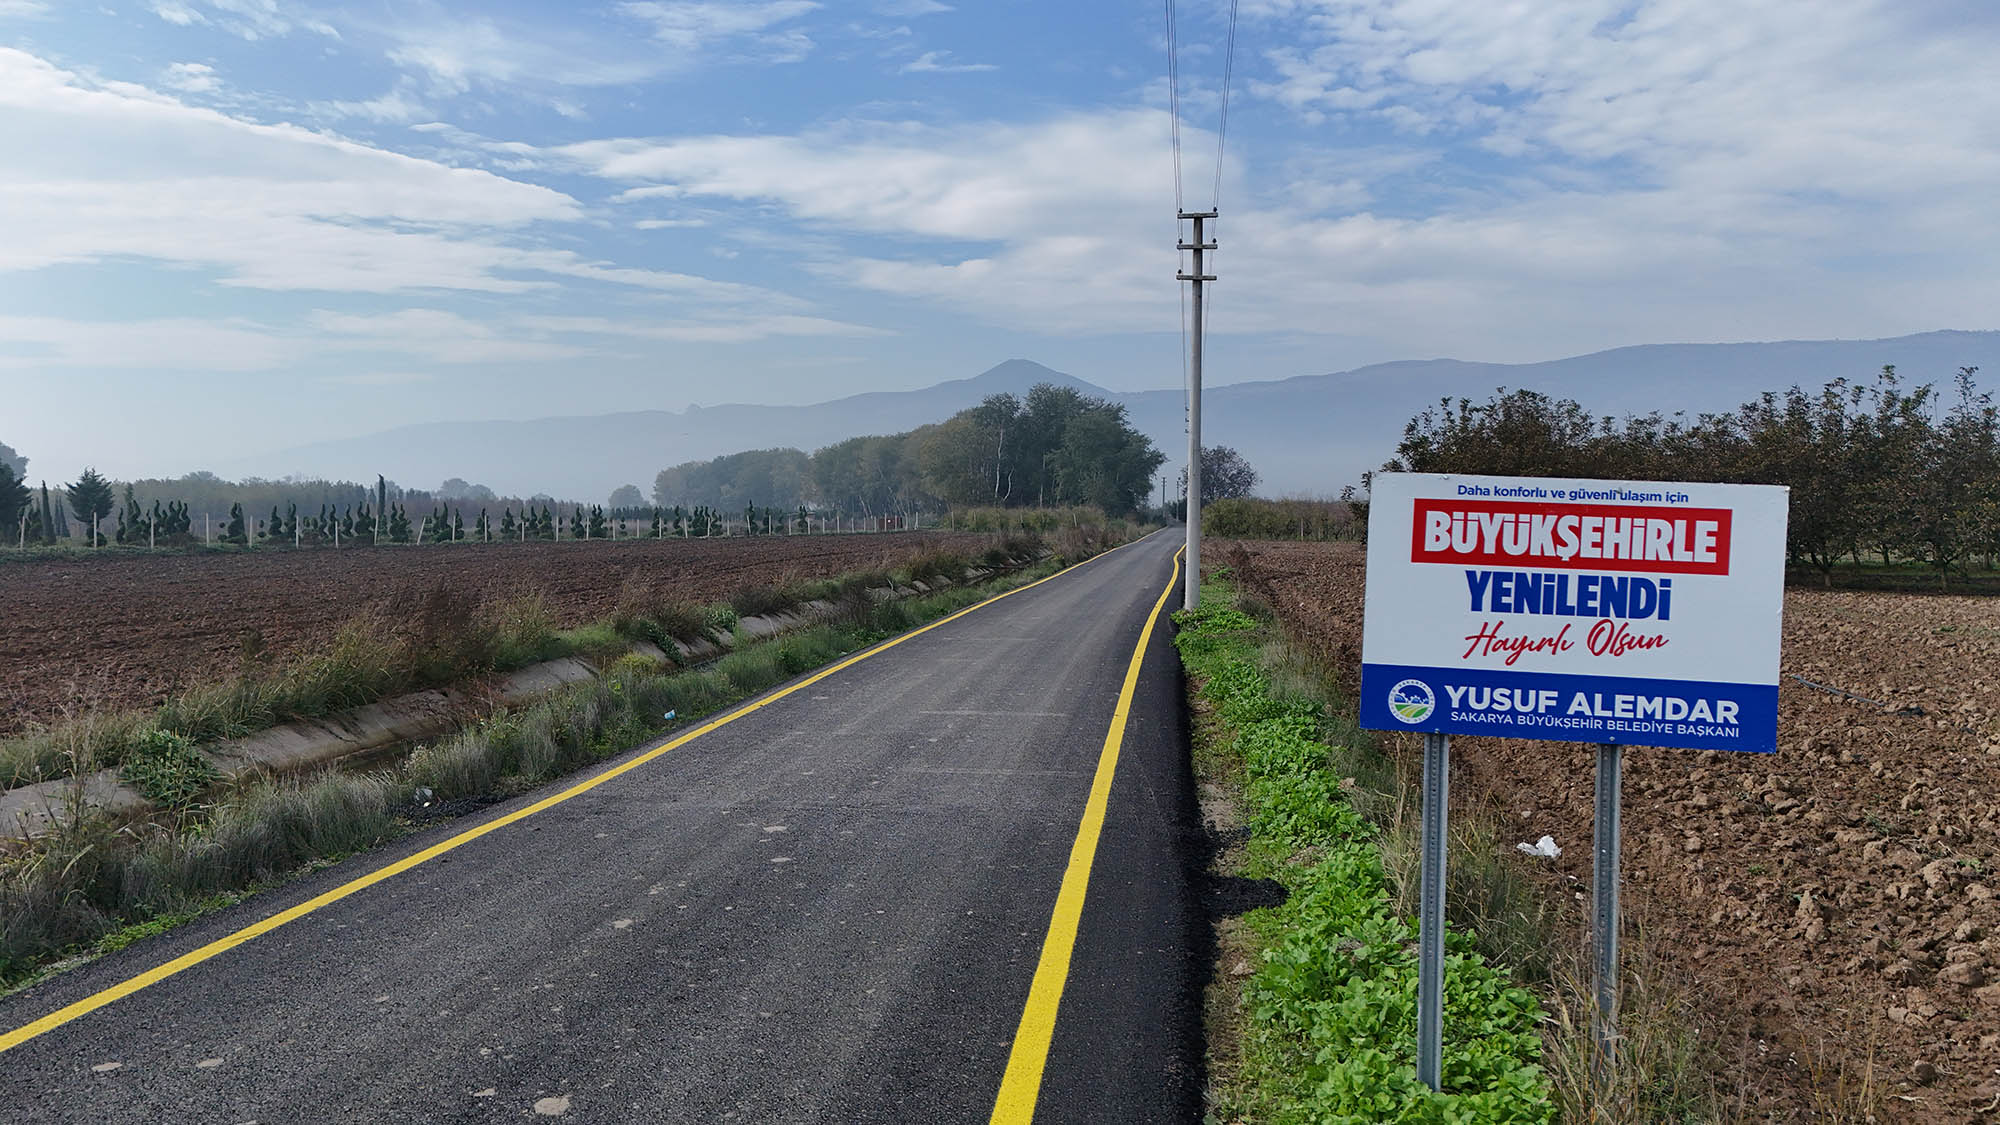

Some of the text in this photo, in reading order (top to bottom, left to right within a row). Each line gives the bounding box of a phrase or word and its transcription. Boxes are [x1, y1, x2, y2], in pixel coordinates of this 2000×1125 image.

[1457, 485, 1689, 504] Daha konforlu ve güvenli ulaşım için
[1463, 619, 1669, 666] Hayırlı Olsun
[1444, 685, 1558, 714] YUSUF
[1567, 692, 1739, 724] ALEMDAR
[1451, 711, 1739, 738] SAKARYA BÜYÜKŞEHİR BELEDİYE BAŞKANI
